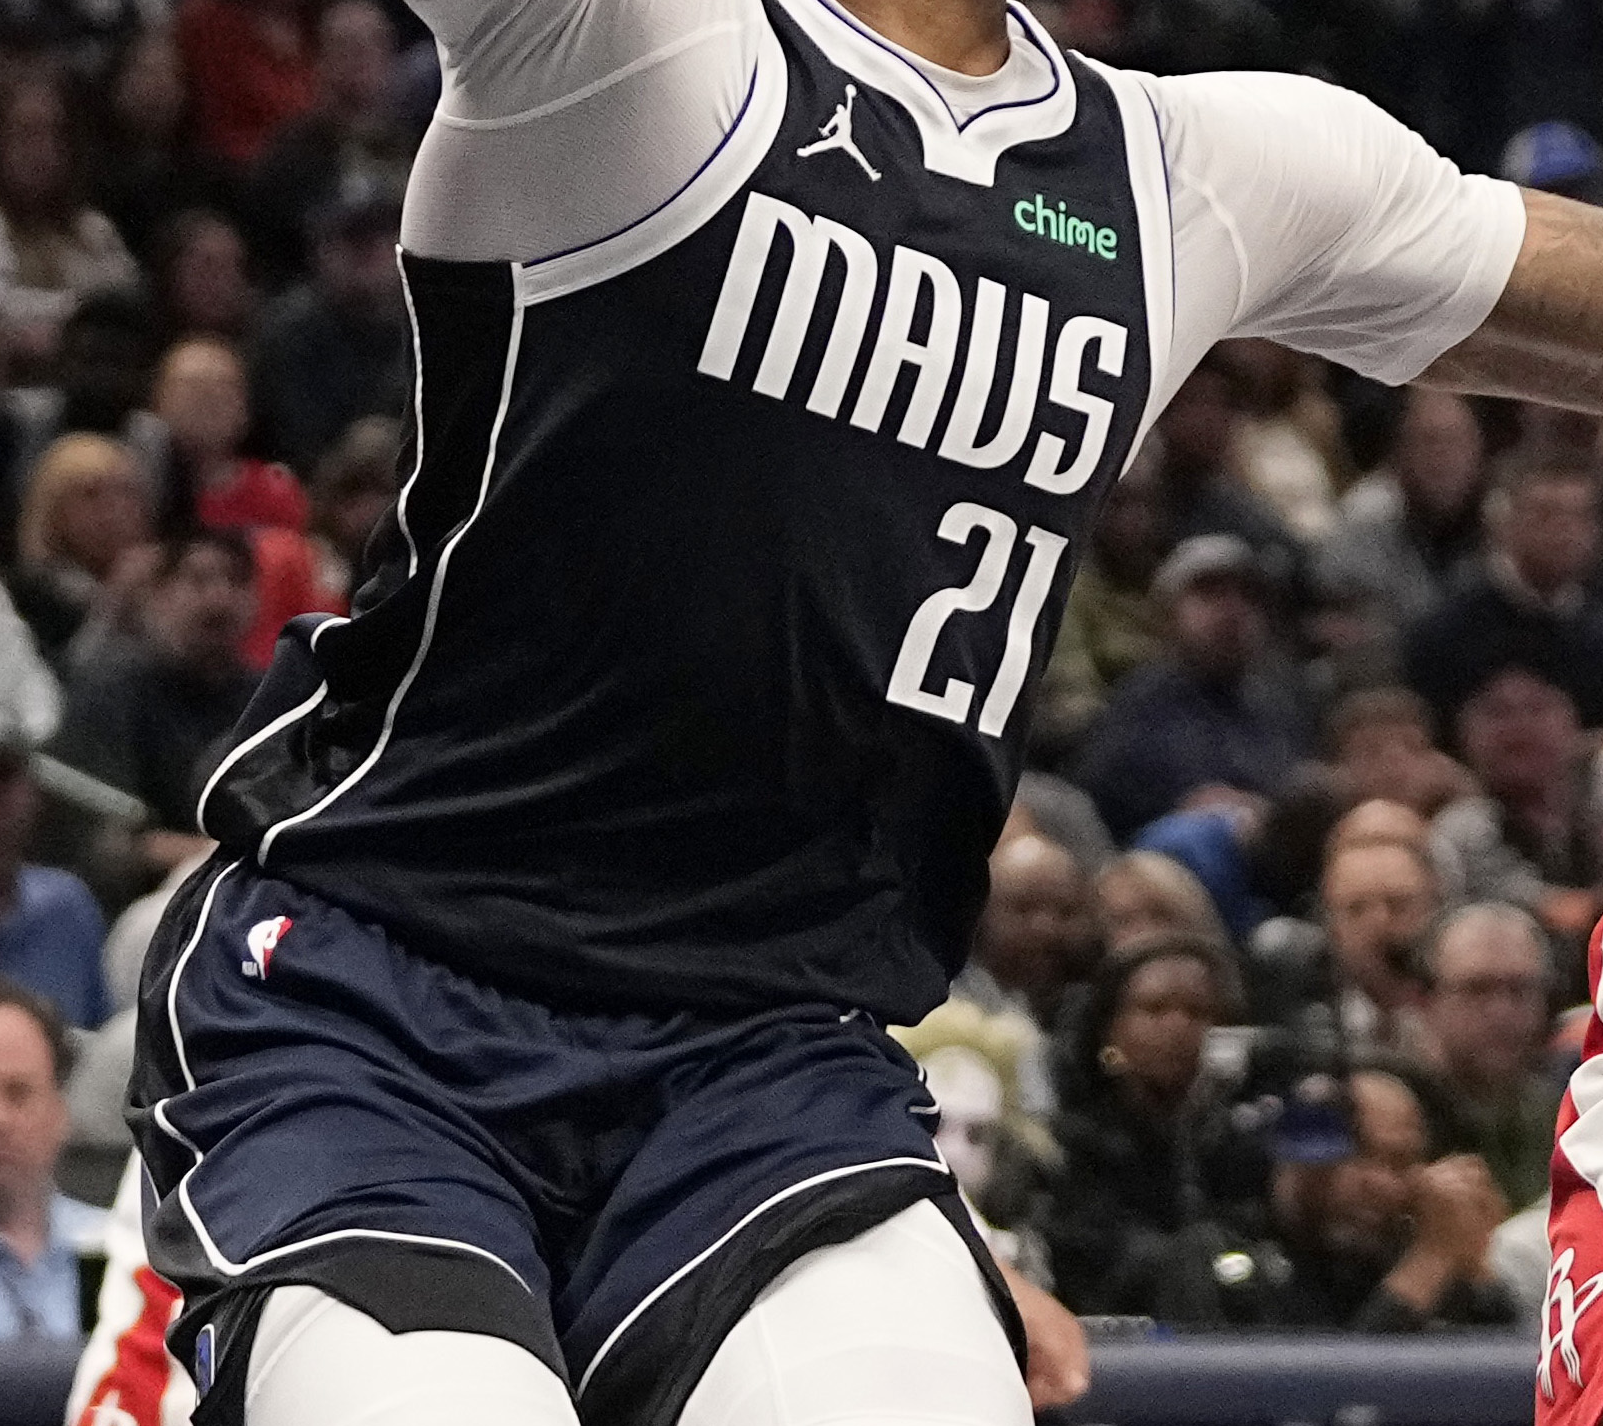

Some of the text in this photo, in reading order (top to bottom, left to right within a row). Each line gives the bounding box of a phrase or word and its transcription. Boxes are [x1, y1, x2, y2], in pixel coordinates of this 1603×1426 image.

[696, 191, 1130, 496] MAVS
[1012, 192, 1119, 262] chime
[885, 501, 1068, 740] 21
